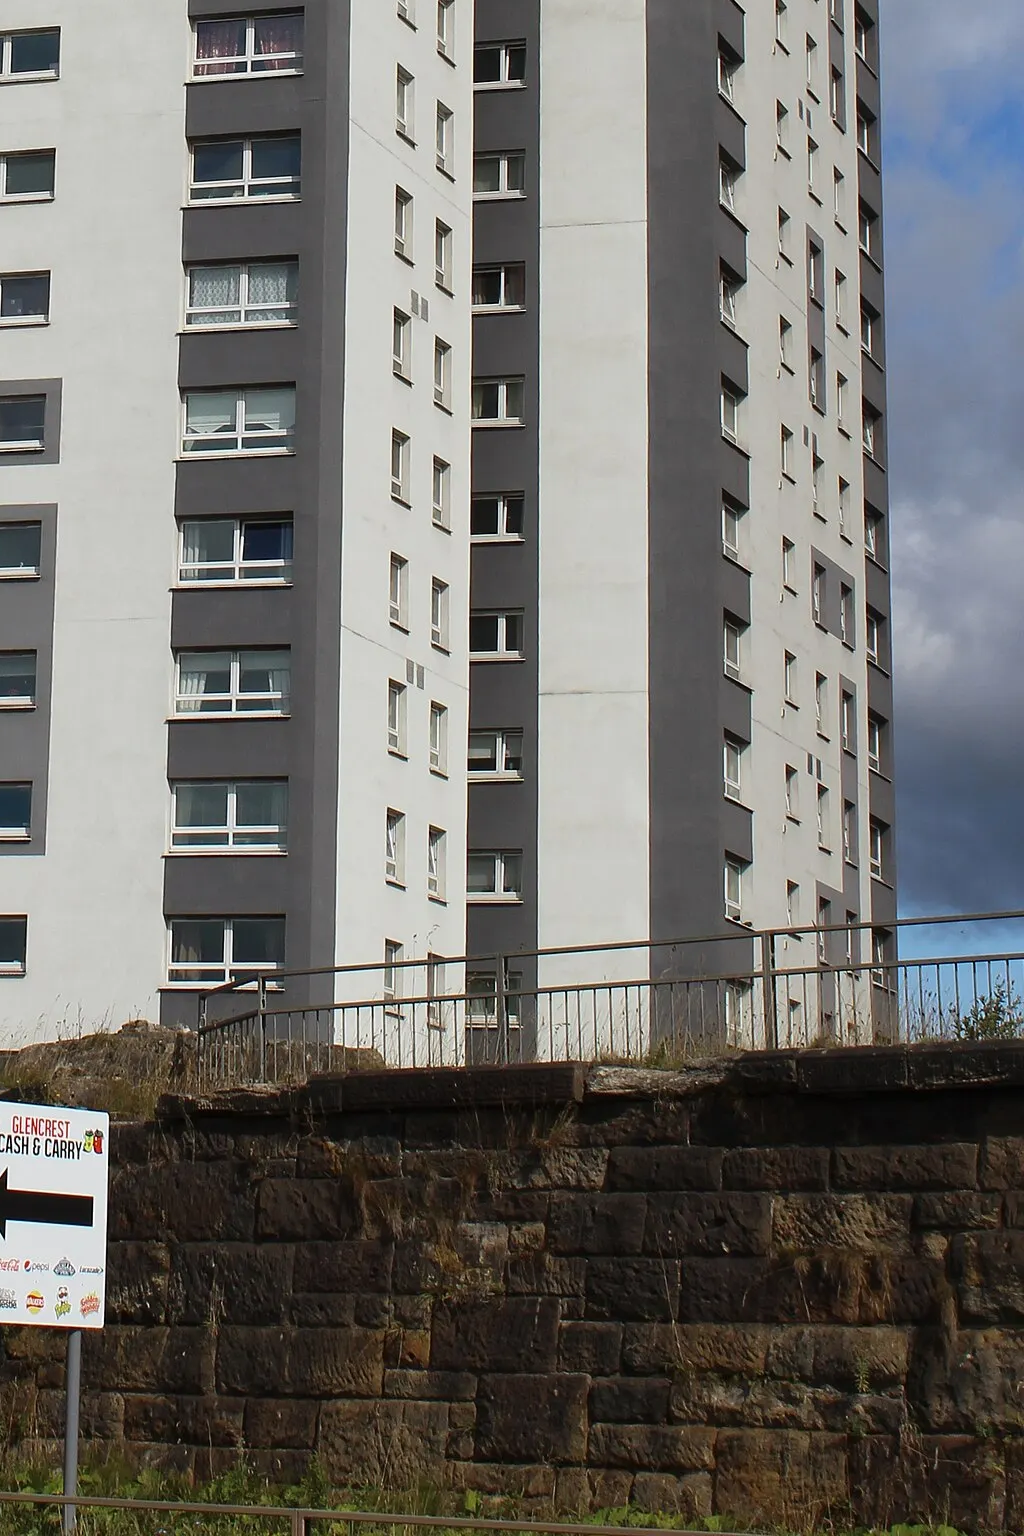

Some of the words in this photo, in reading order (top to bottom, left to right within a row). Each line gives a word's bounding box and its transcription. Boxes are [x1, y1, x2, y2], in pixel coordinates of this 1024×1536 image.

[12, 1115, 71, 1139] GLENCREST
[32, 1137, 41, 1156] &
[44, 1138, 83, 1160] CARRY
[32, 1263, 50, 1272] pepsi
